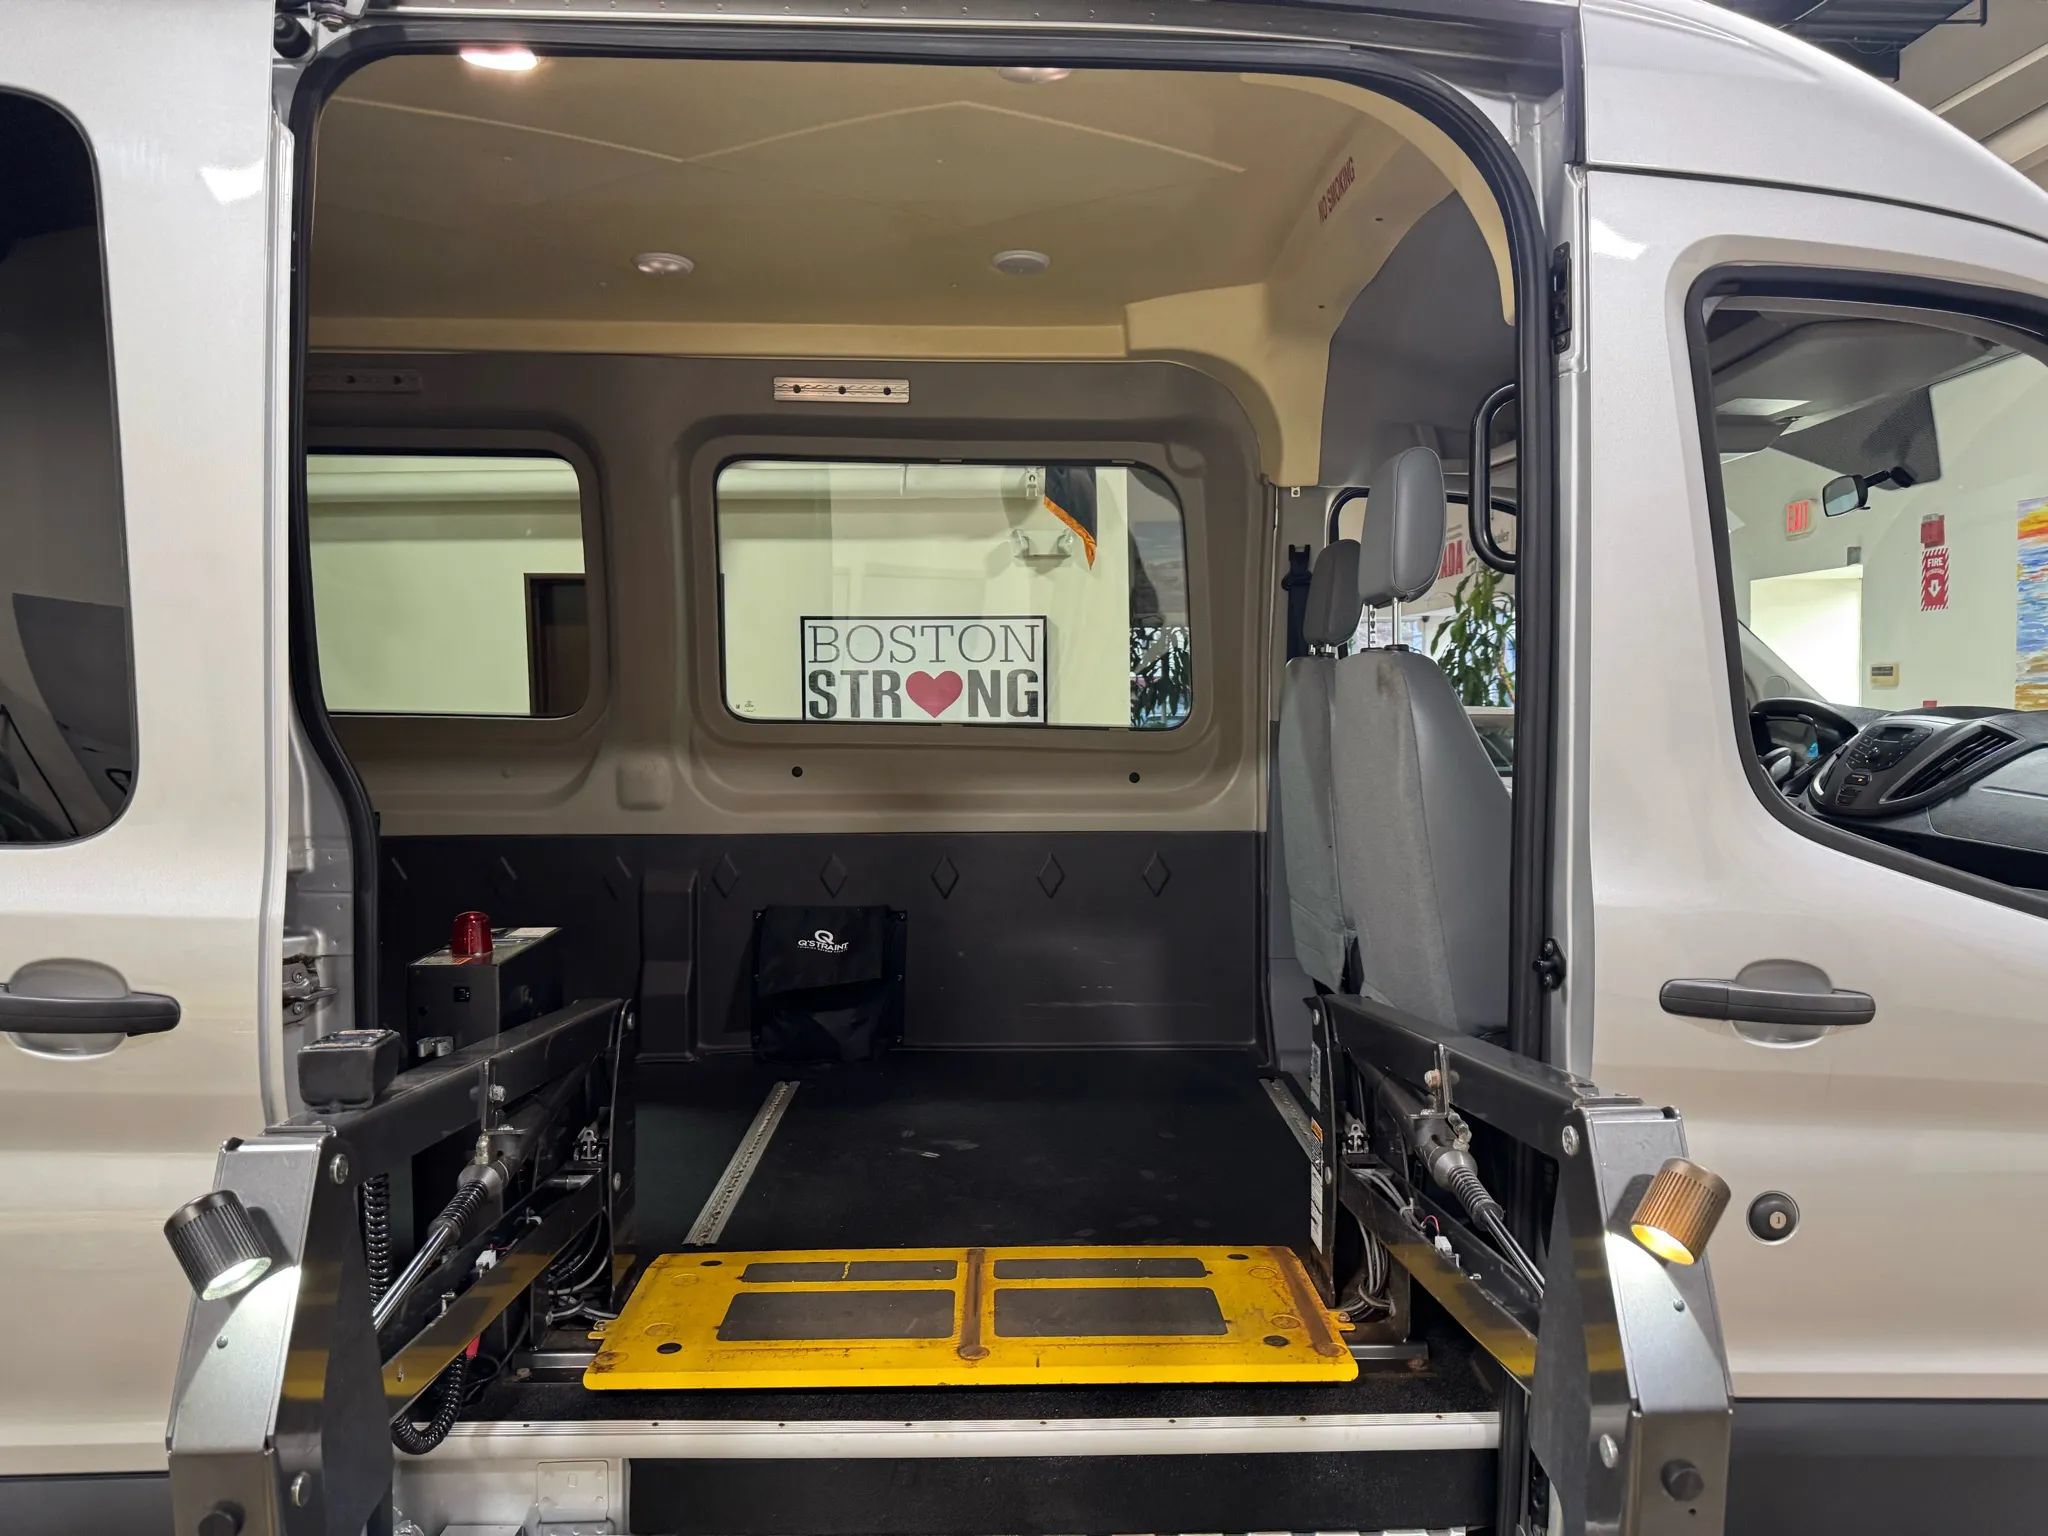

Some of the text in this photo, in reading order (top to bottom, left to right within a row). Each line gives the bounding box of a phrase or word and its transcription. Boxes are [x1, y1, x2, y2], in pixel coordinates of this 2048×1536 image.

[1318, 156, 1355, 224] NO SMOKING
[1786, 502, 1808, 531] EXIT
[1927, 557, 1944, 568] FIRE
[808, 624, 1040, 664] BOSTON
[808, 669, 1039, 719] STRNG
[798, 940, 849, 951] Q'STRAINT
